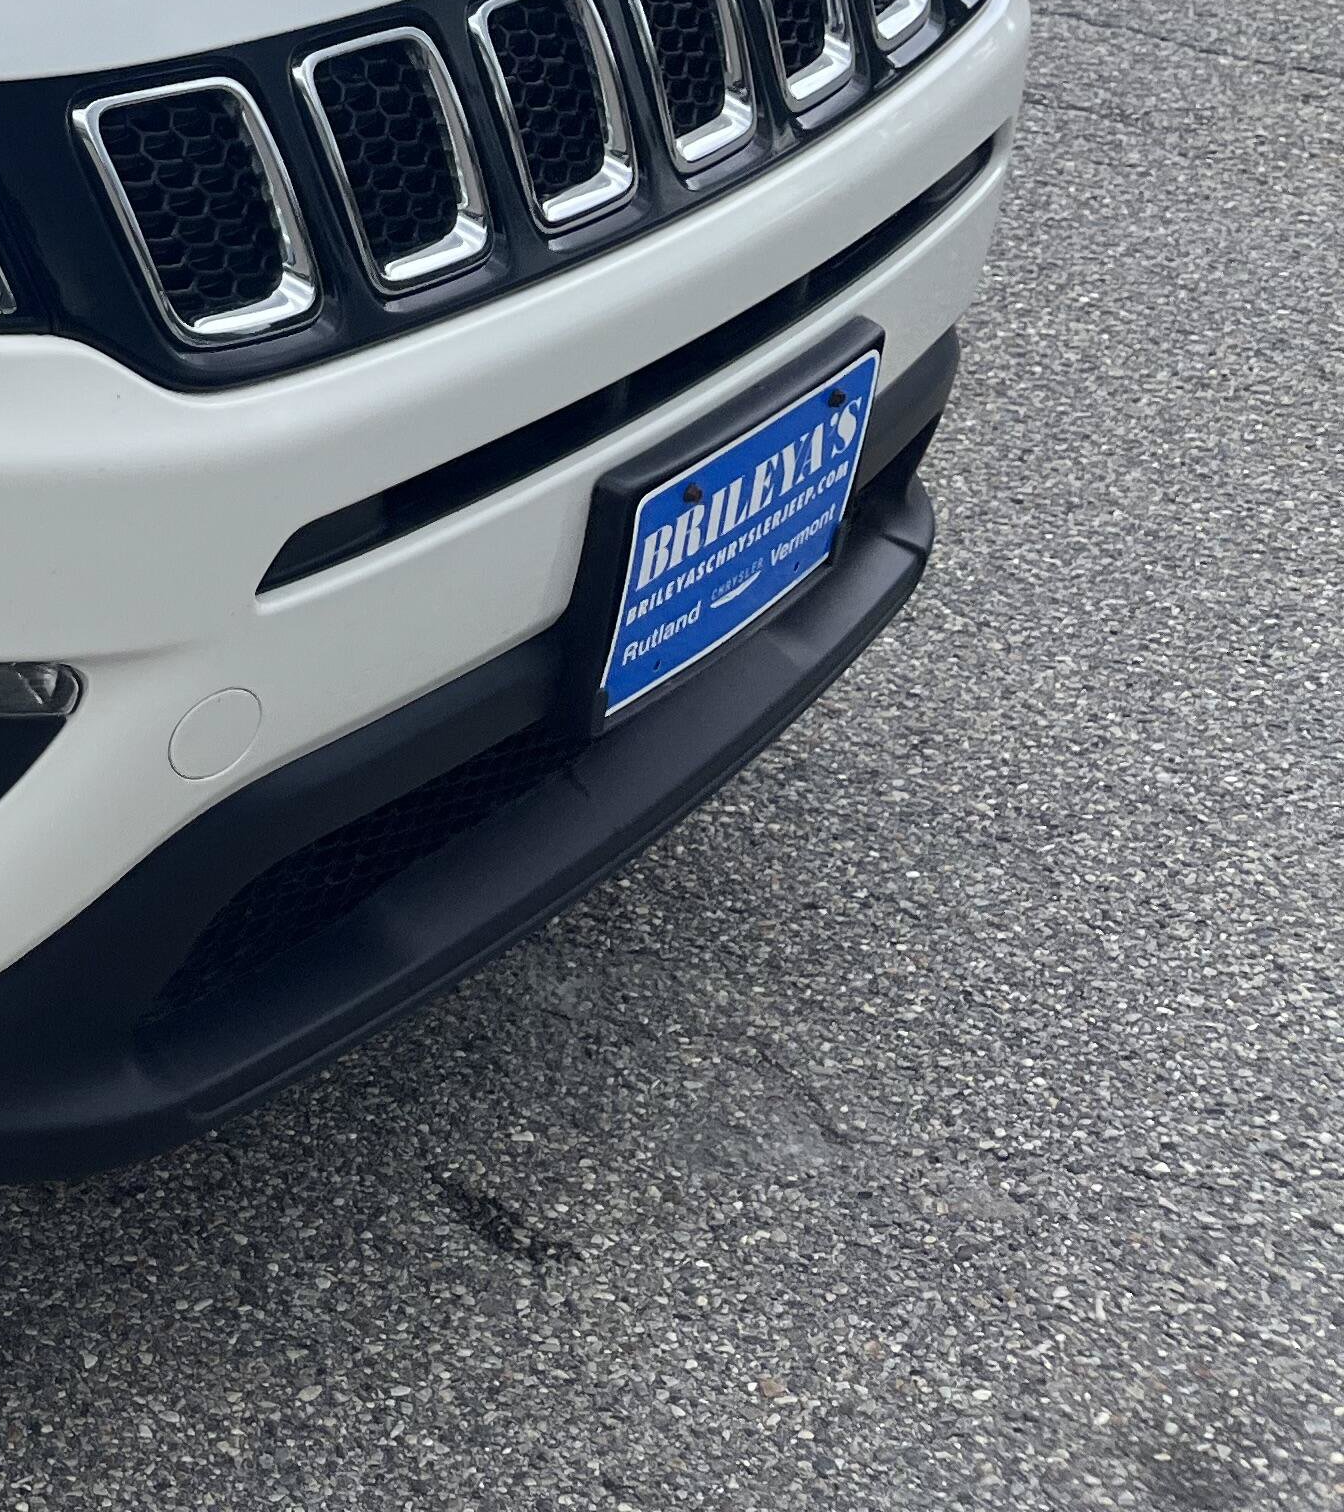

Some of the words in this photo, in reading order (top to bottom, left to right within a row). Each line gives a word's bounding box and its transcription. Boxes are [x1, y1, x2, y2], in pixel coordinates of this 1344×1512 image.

[625, 462, 848, 626] BRILEYASCHRYSLERJEEP.COM
[636, 396, 862, 592] BRILEYA'S
[621, 601, 703, 667] Rutland
[711, 557, 763, 601] CHRYSLER
[770, 502, 837, 567] Vermont
